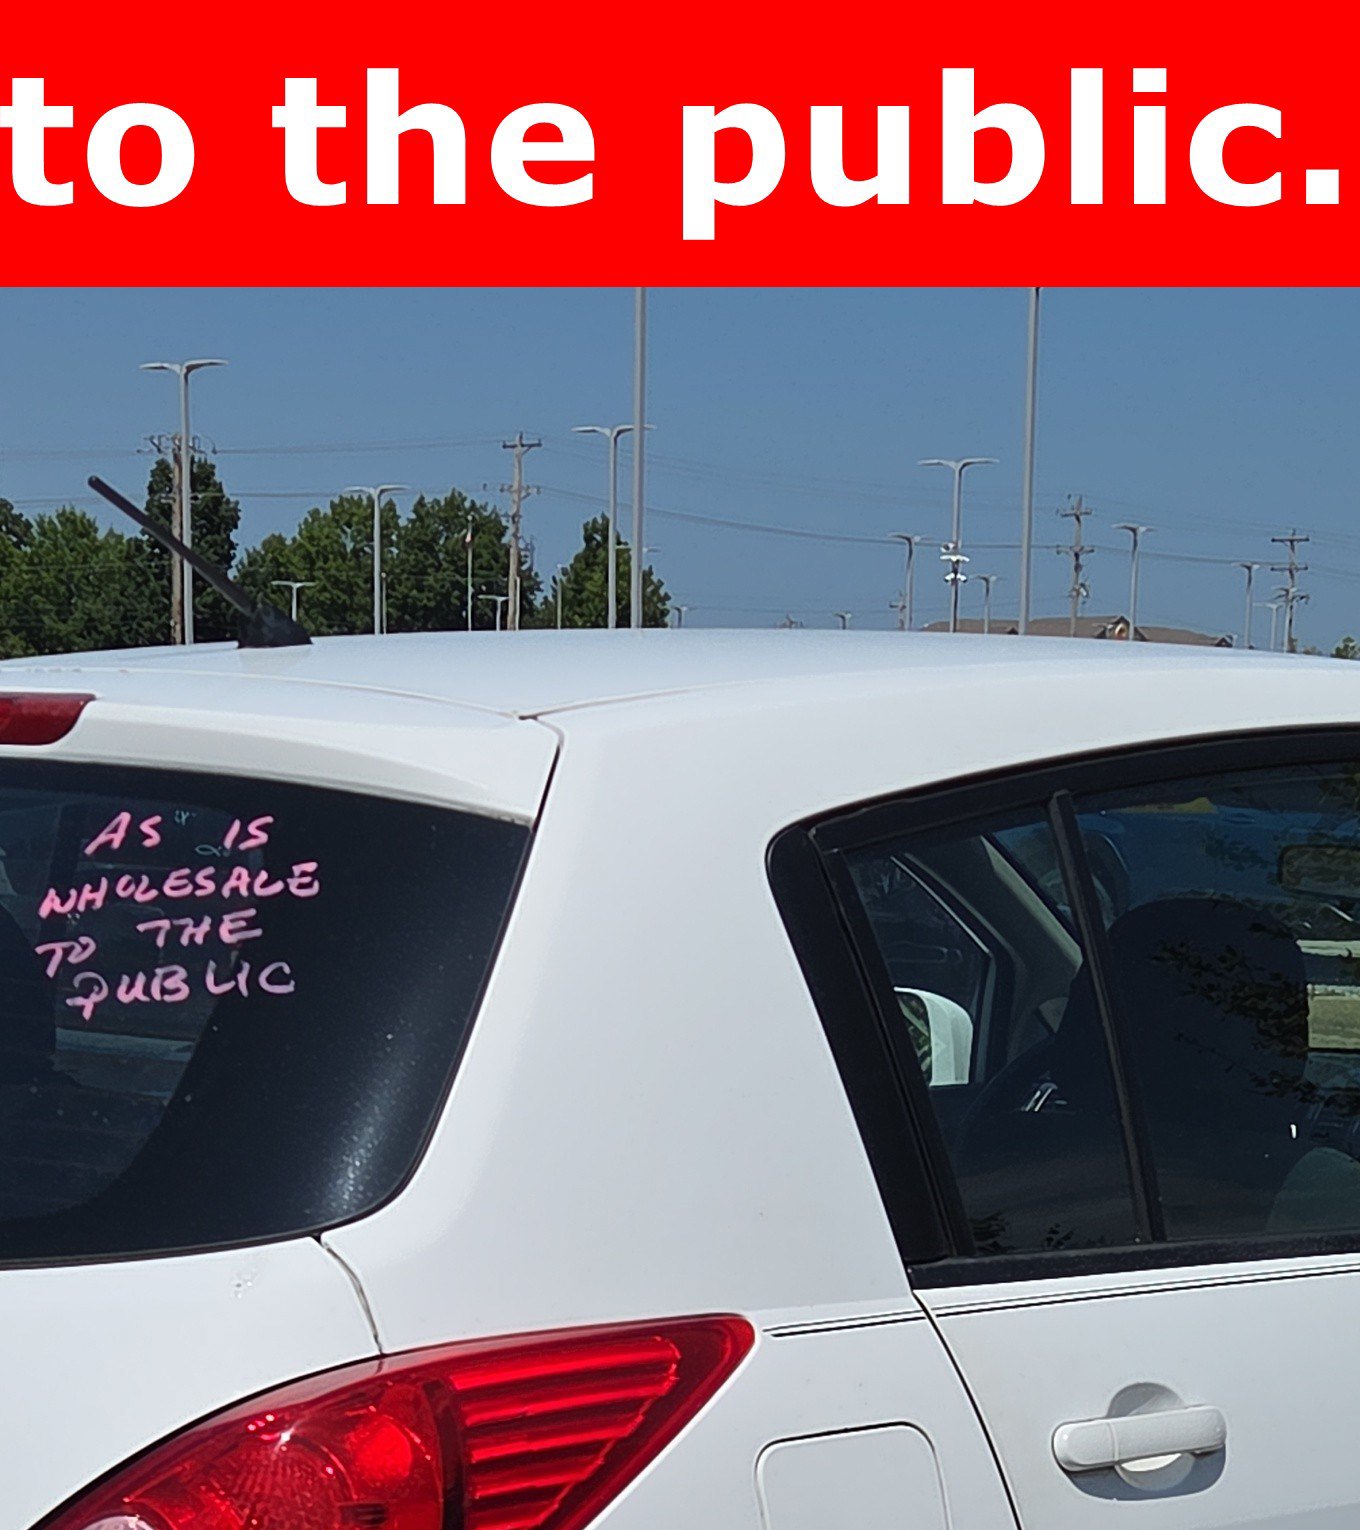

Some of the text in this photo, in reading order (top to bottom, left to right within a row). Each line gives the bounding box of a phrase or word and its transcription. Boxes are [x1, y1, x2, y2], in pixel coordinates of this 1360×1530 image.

[84, 811, 274, 855] AS IS
[39, 861, 321, 919] WHOLESALE
[35, 907, 264, 978] TO THE
[66, 959, 296, 1021] PUBLIC
